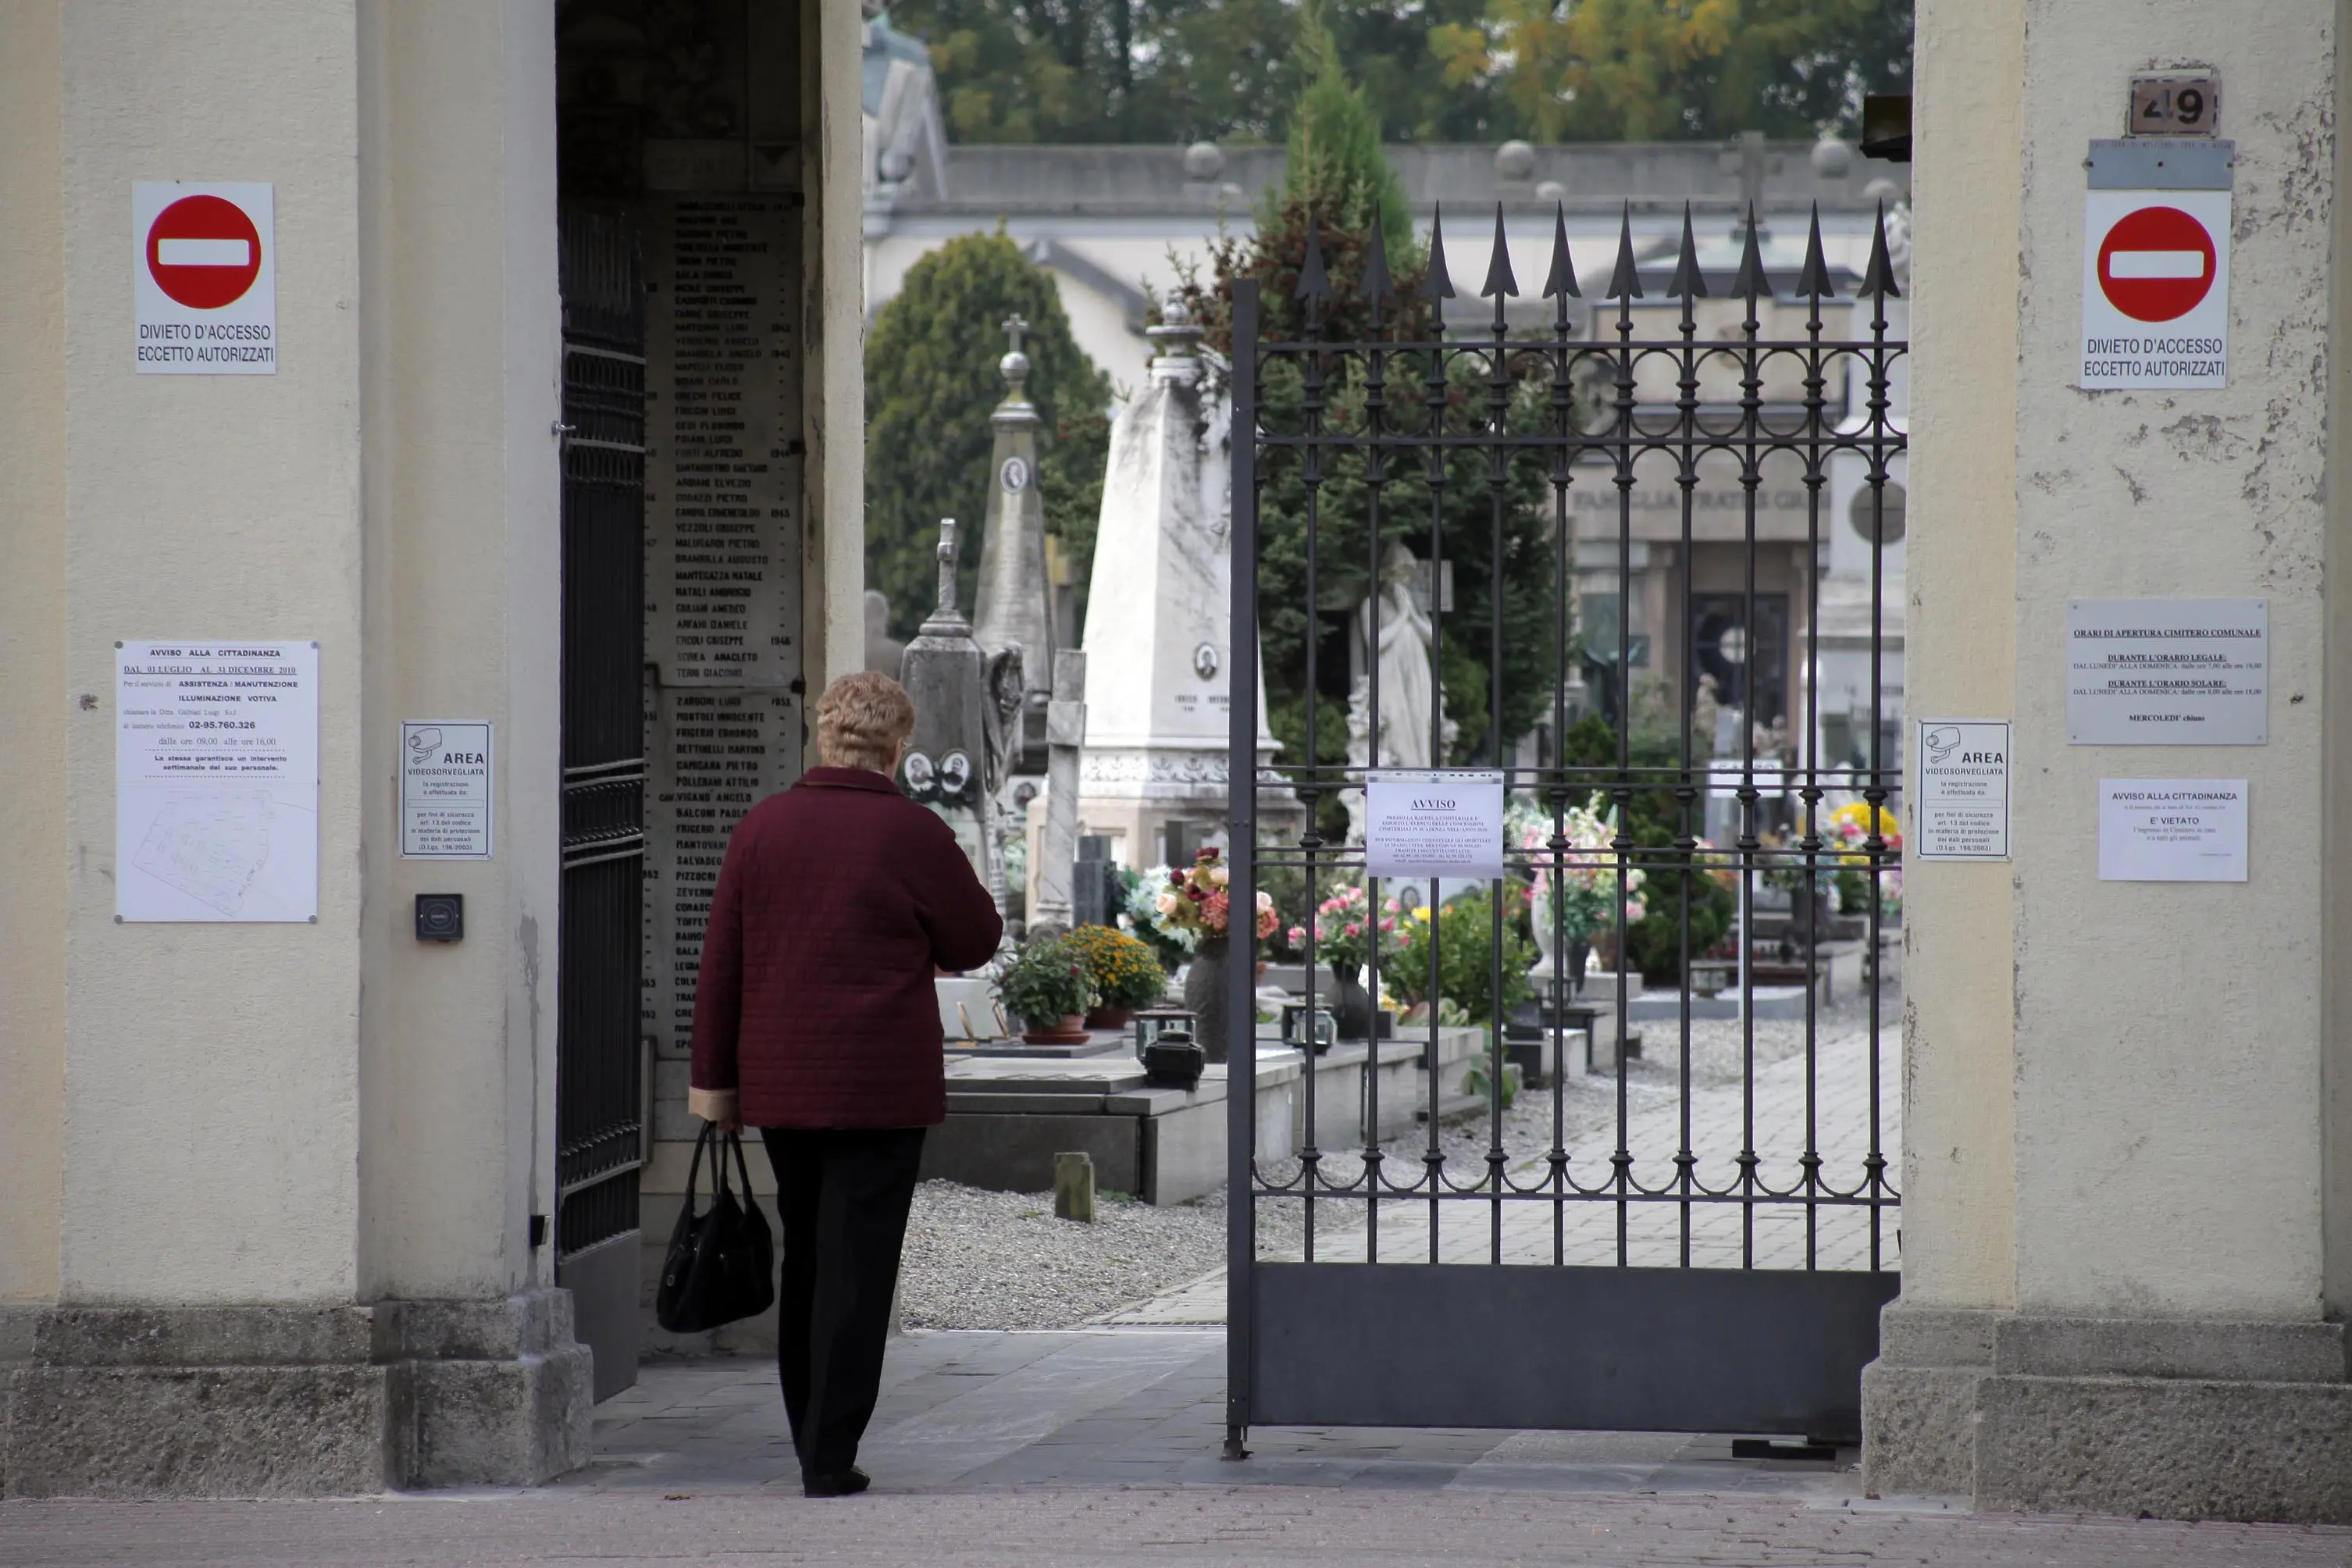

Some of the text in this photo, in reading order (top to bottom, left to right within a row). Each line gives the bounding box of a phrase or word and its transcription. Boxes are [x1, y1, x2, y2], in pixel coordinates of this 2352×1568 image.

[140, 324, 271, 340] DIVIETO D'ACCESSO
[2087, 338, 2222, 354] DIVIETO D'ACCESSO
[137, 347, 273, 362] ECCETTO AUTORIZZATI
[2084, 361, 2225, 376] ECCETTO AUTORIZZATI
[2108, 654, 2227, 662] DURANTE L'ORARIO LEGALE:
[2108, 679, 2227, 688] DURANTE L'ORARIO SOLARE:
[188, 721, 256, 729] 02-95.760.326
[675, 728, 715, 738] FRIGERIO
[159, 737, 176, 746] dalle
[180, 737, 193, 746] ore
[223, 737, 237, 746] alle
[241, 737, 254, 746] ore
[676, 743, 765, 754] BETTINELLI MARTINO
[443, 753, 484, 764] AREA
[1962, 752, 2004, 764] AREA
[725, 777, 760, 787] ATTILIO
[716, 793, 752, 803] ANGELO
[1410, 799, 1456, 809] AVVISO
[675, 808, 715, 818] BALCONI
[675, 825, 715, 834] FRIGERIO
[675, 871, 716, 882] PIZZOCRI
[675, 947, 700, 956] SALA
